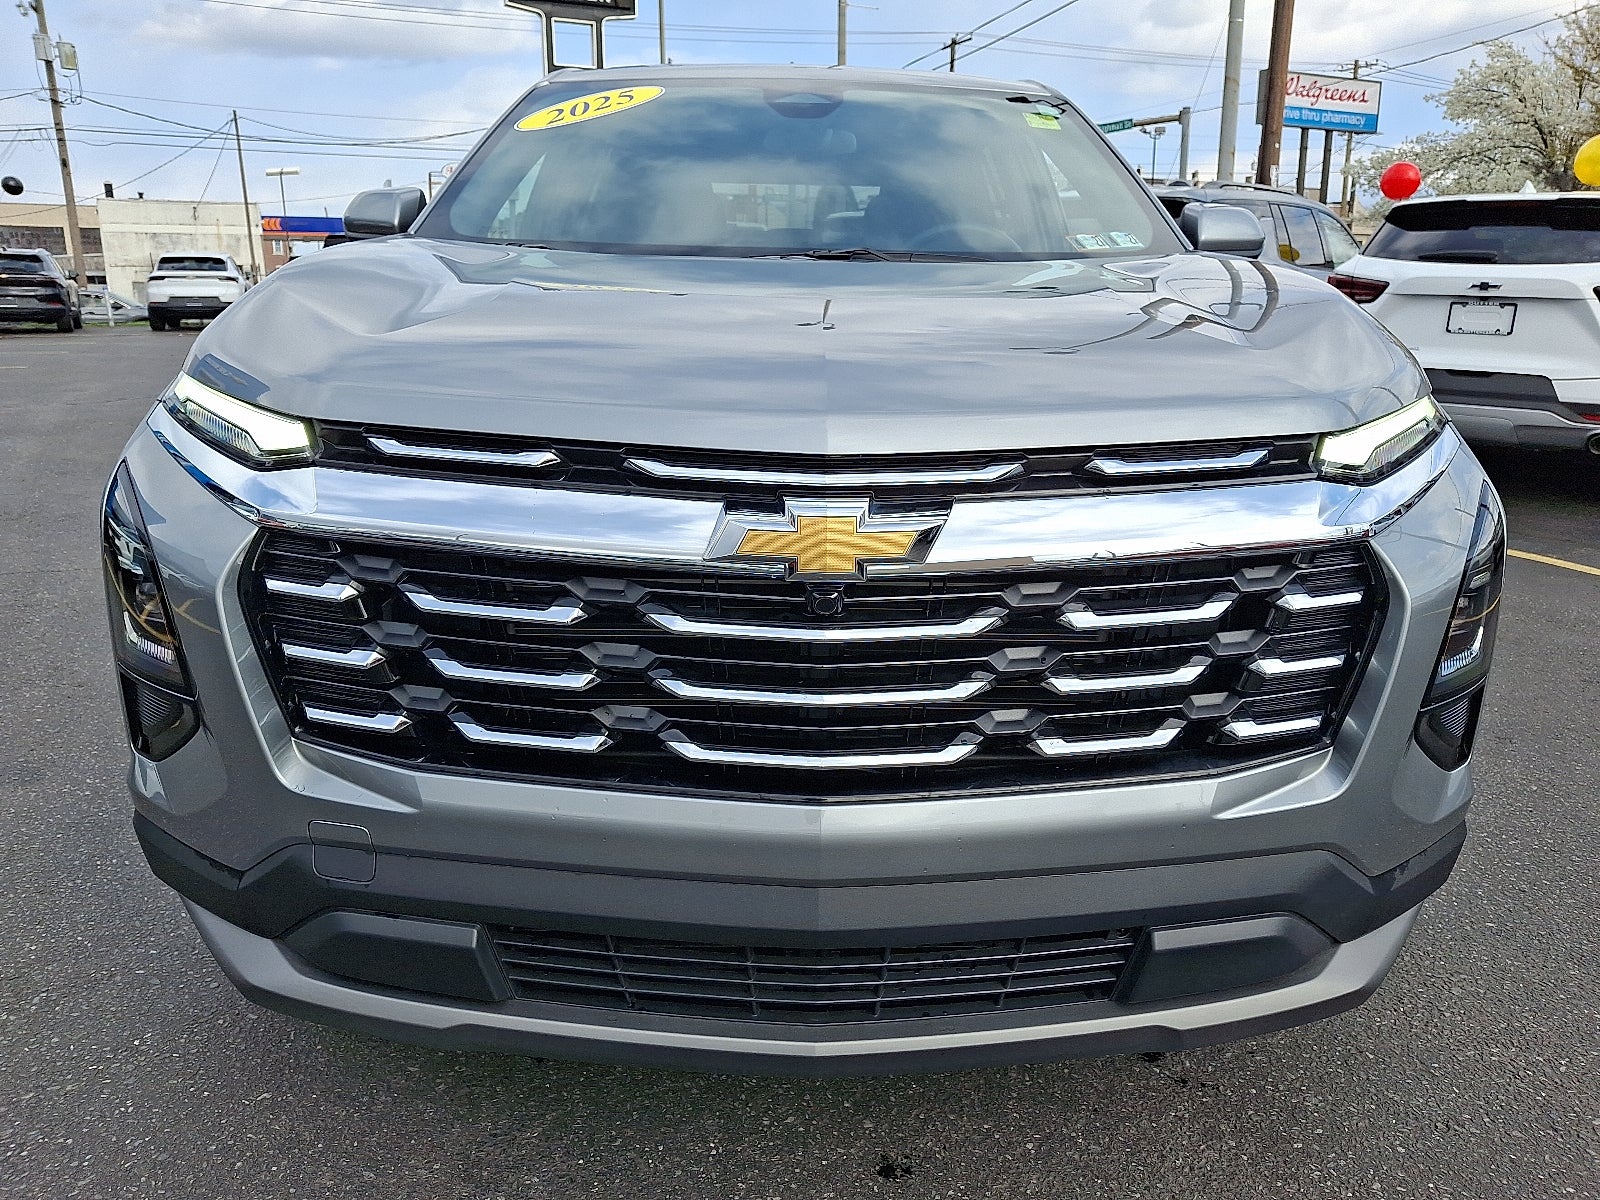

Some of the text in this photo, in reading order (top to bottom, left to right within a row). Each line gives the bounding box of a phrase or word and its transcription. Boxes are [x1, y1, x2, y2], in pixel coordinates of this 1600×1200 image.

[1285, 75, 1368, 106] Walgreens
[546, 89, 634, 125] 2025
[1284, 108, 1366, 128] rive thru pharmacy
